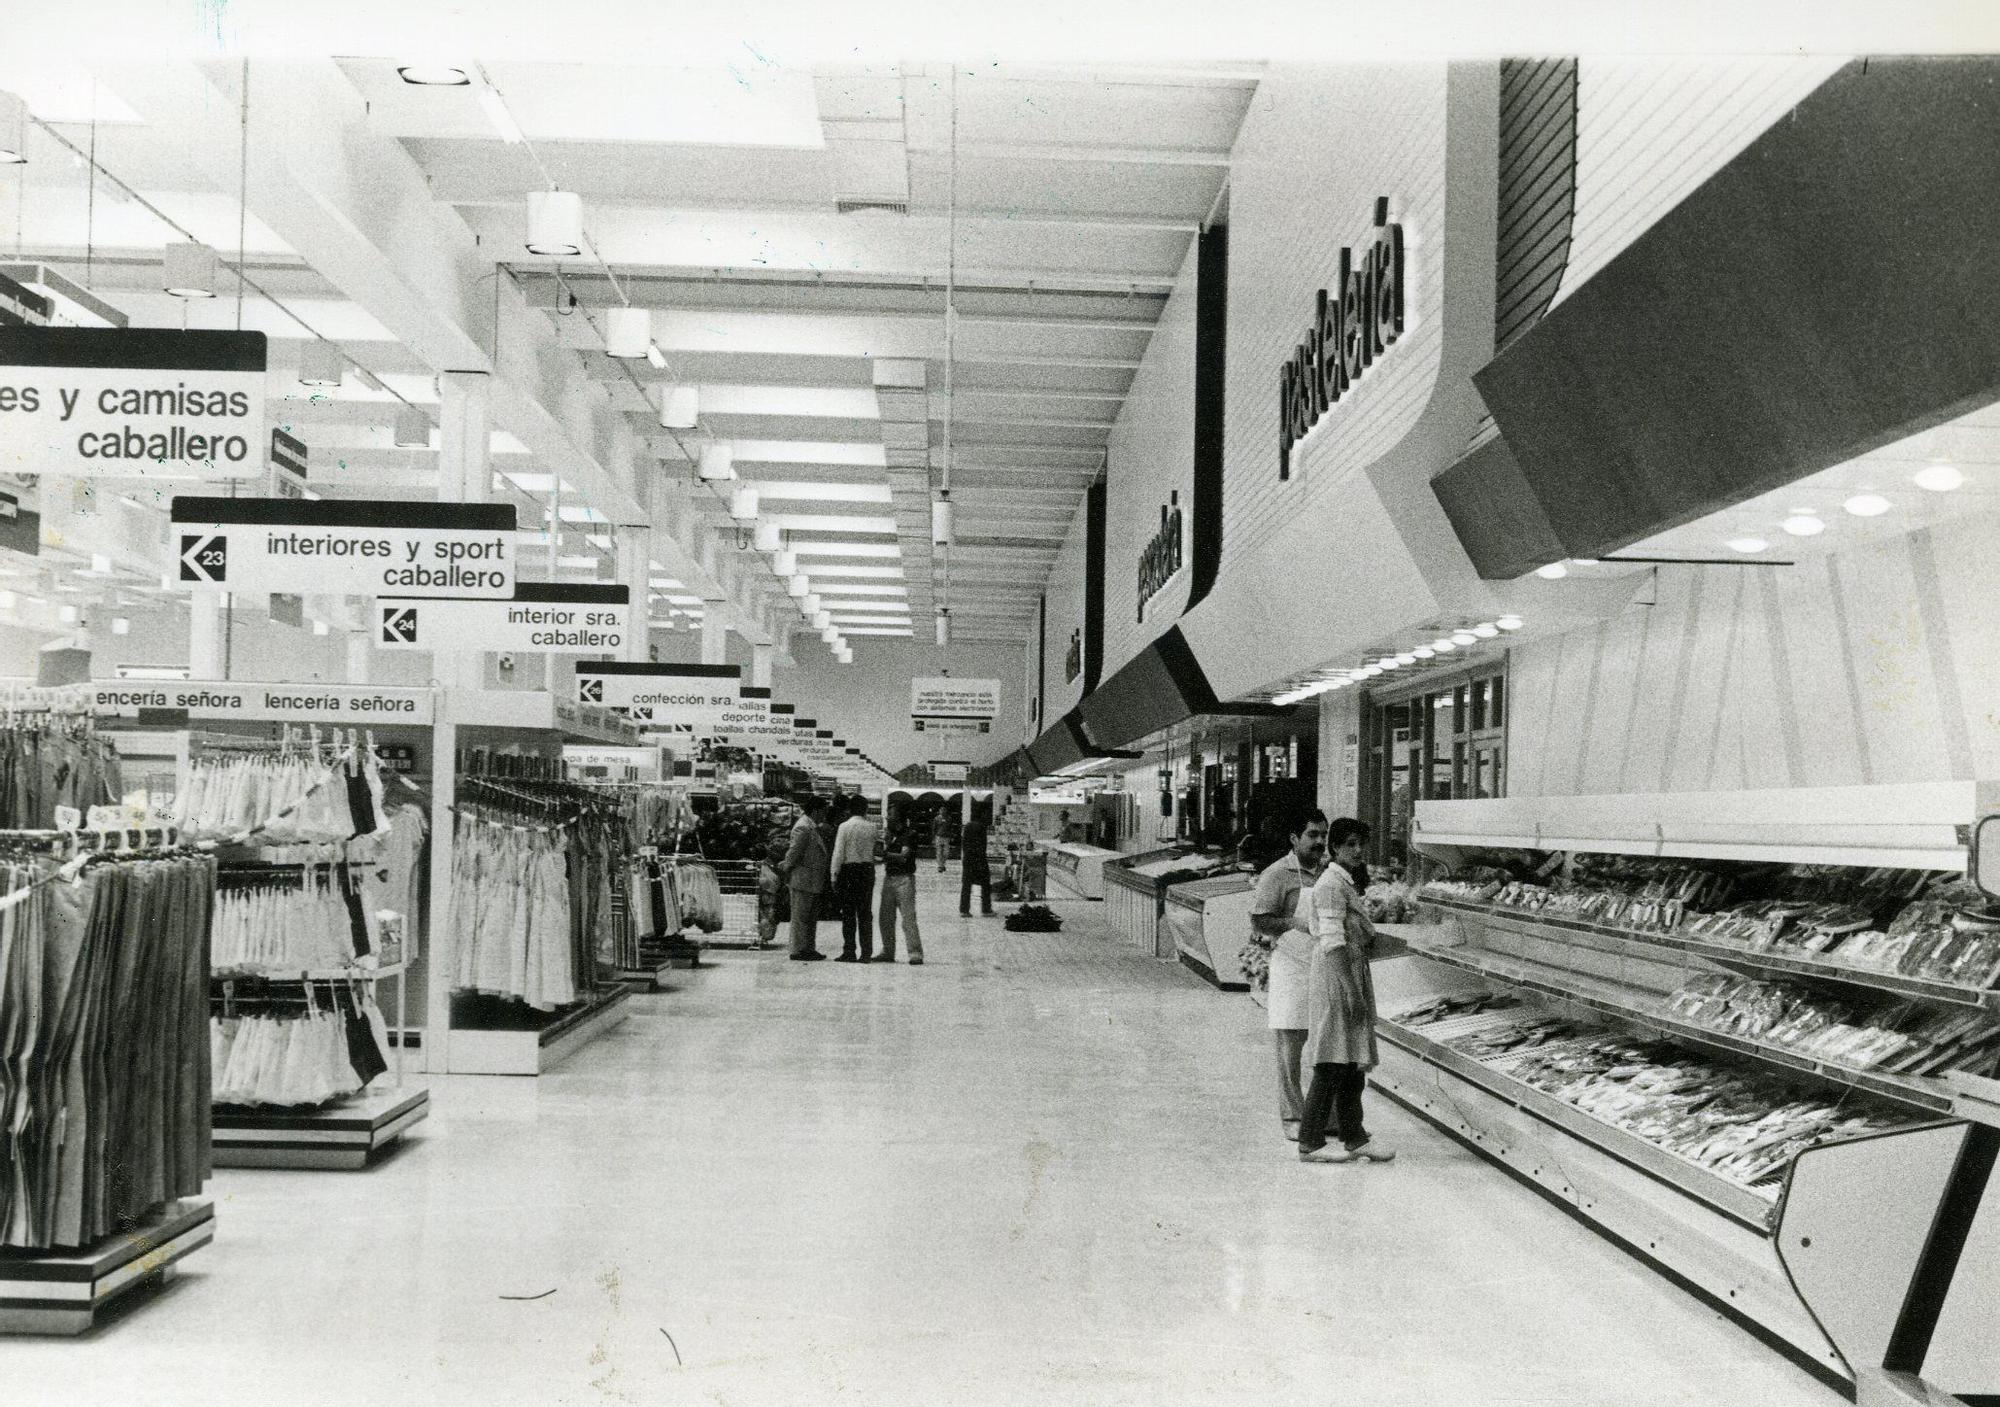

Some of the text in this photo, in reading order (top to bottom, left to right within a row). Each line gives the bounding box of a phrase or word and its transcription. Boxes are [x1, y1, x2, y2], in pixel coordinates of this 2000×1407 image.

[0, 382, 249, 422] es y camisas
[78, 425, 248, 462] caballero
[268, 532, 504, 562] interiores y sport
[202, 551, 225, 566] 23
[383, 564, 505, 588] caballero
[398, 620, 416, 631] 24
[508, 608, 621, 626] interior sra.
[531, 630, 621, 647] caballero
[590, 686, 602, 694] 26
[632, 692, 705, 705] confección
[96, 689, 242, 709] encería señora
[265, 691, 416, 712] lencería señora
[721, 712, 766, 723] deporte
[713, 725, 745, 733] toallas
[586, 755, 599, 763] de
[603, 756, 632, 764] mesa
